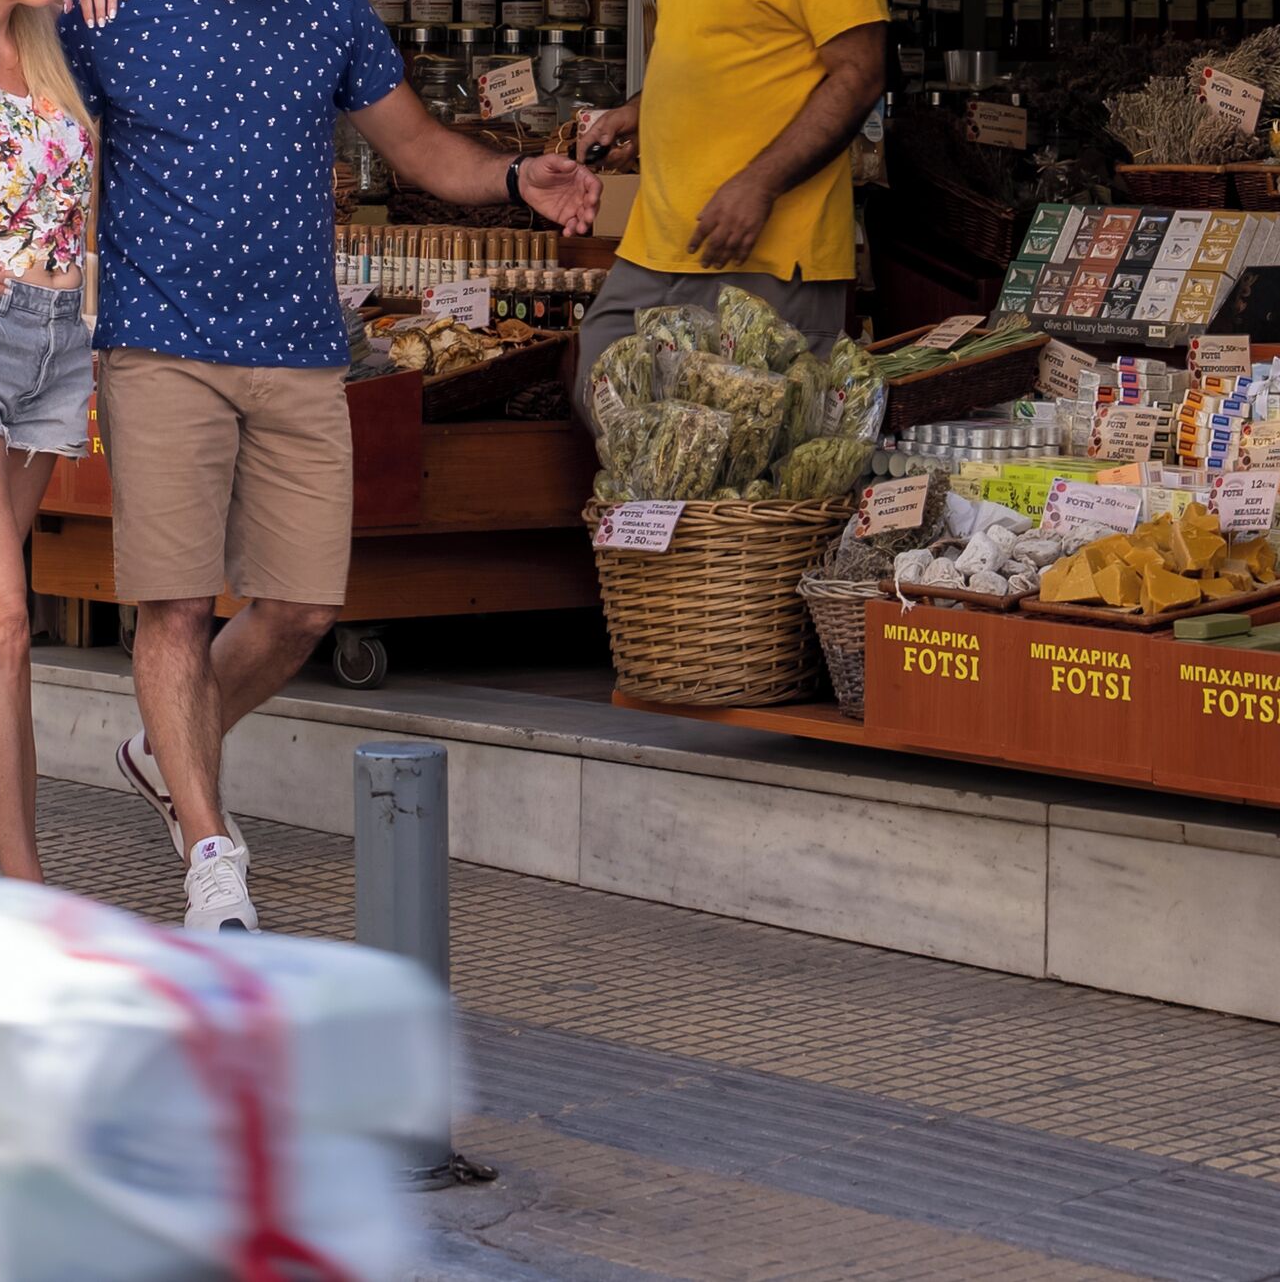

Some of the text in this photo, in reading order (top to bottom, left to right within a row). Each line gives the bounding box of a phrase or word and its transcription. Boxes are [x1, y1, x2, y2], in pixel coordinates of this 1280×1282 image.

[1211, 82, 1232, 96] FOTSI
[1073, 321, 1096, 334] luxury
[1097, 321, 1115, 334] bath
[1117, 324, 1139, 336] soaps
[1201, 351, 1221, 359] FOTSI
[873, 495, 896, 506] FOTSI
[1222, 489, 1243, 498] FOTSI
[1065, 496, 1095, 509] FOTSI
[619, 510, 644, 519] FOTSI
[884, 624, 980, 651] ΜΠΑΧΑΡΙΚΑ
[1030, 642, 1132, 670] ΜΠΑΧΑΡΙΚΑ
[903, 646, 980, 682] FOTSI
[1051, 666, 1132, 702] FOTSI
